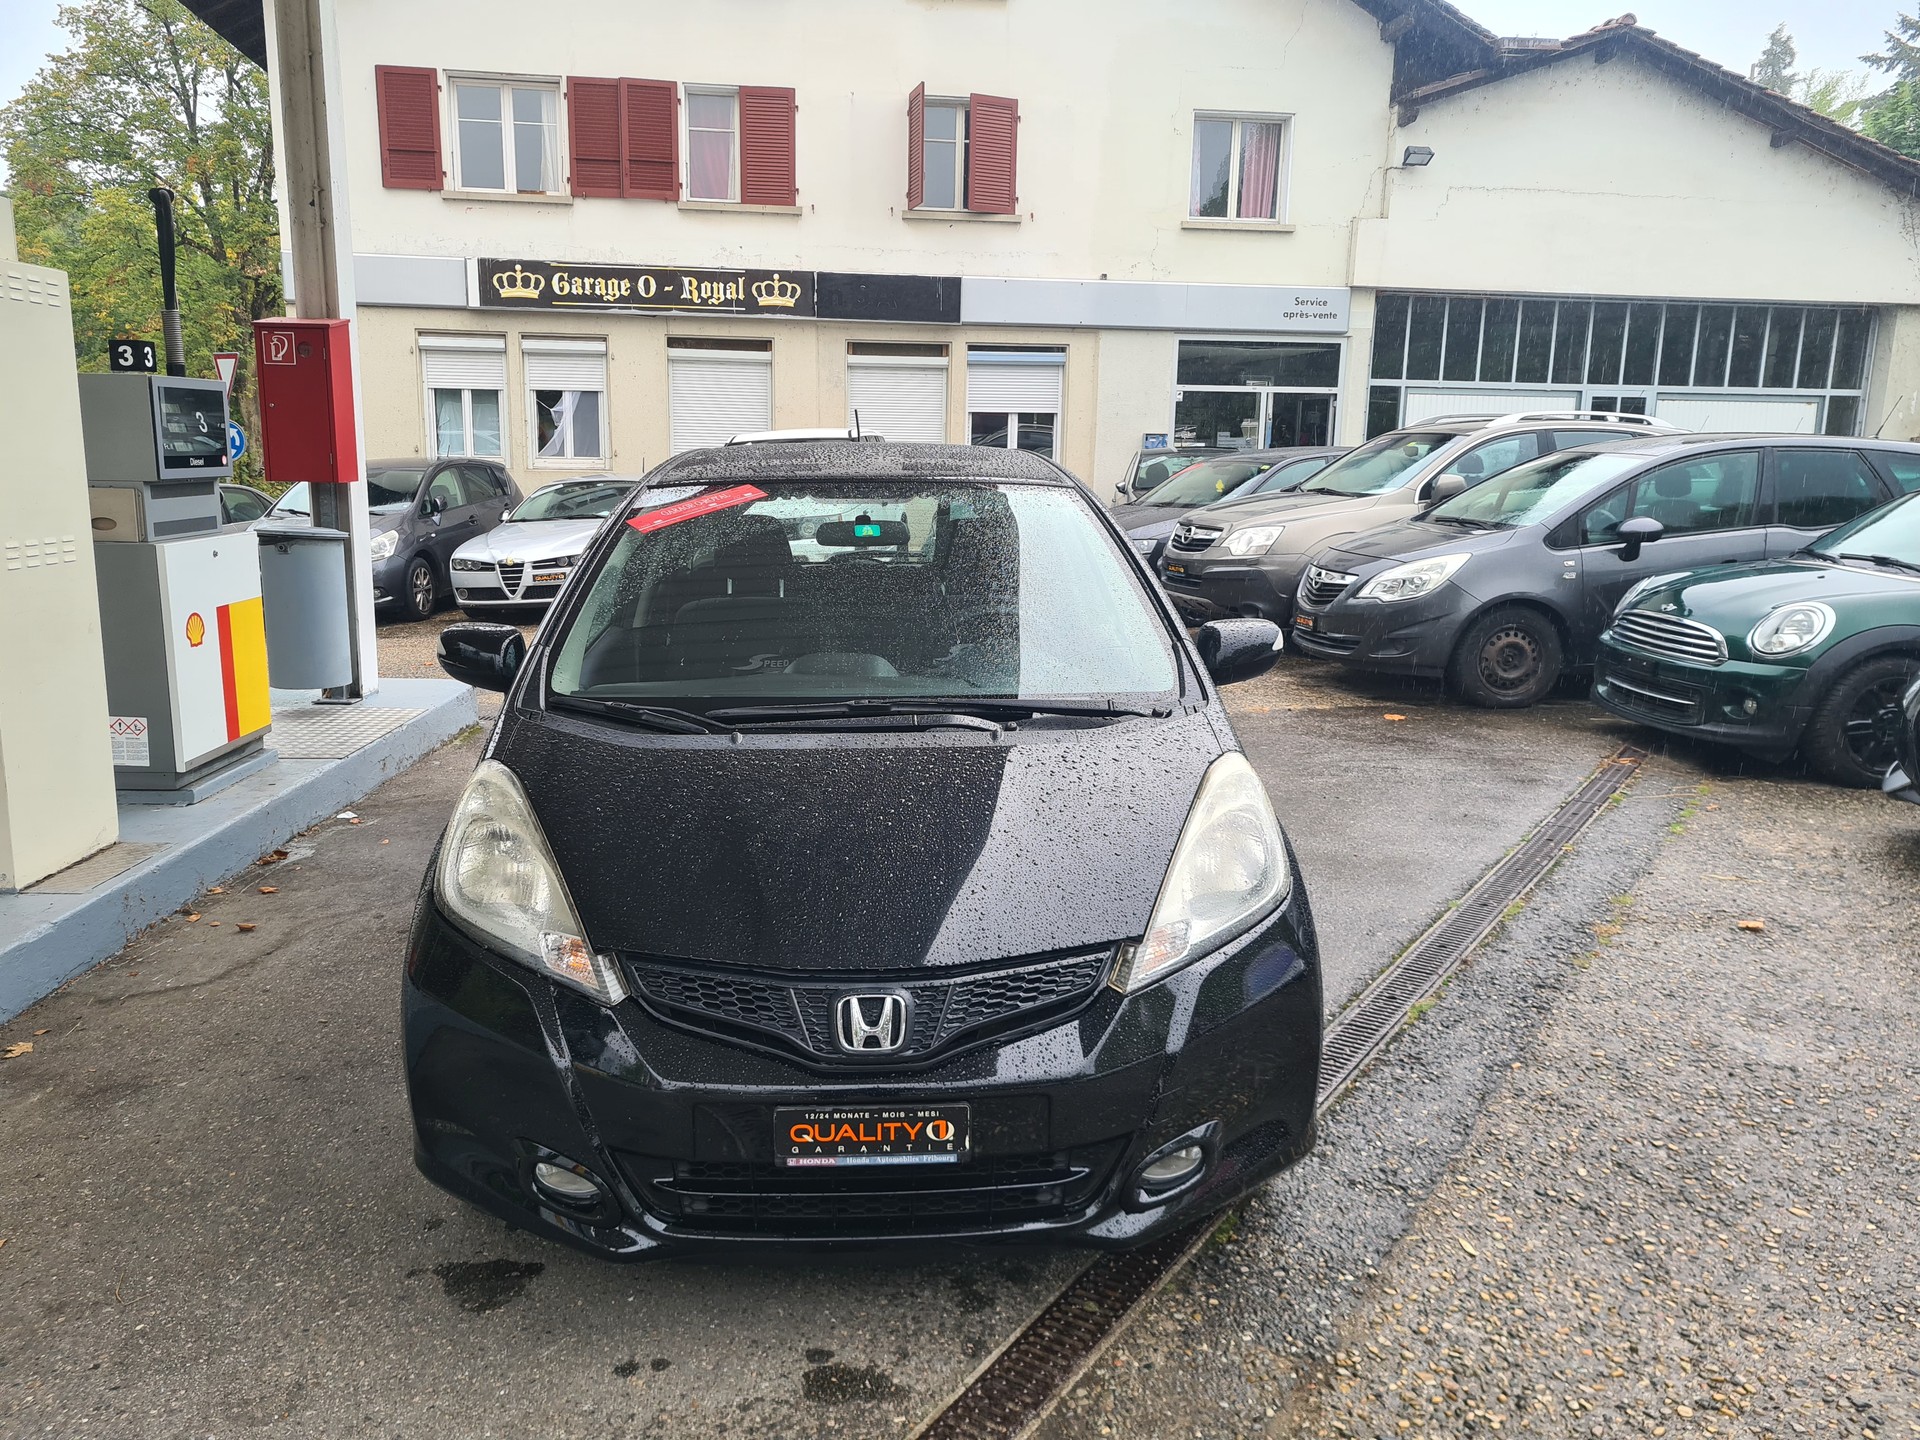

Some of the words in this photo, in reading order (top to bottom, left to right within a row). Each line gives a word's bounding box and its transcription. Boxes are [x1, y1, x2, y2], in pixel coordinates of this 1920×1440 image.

[551, 272, 631, 302] Garage
[637, 275, 657, 298] O
[680, 276, 746, 305] Royal
[1294, 296, 1328, 307] Service
[1282, 310, 1338, 321] après-vente
[117, 344, 134, 367] 3
[143, 346, 154, 368] 3
[195, 411, 208, 433] 3
[189, 457, 205, 466] Diesel
[790, 1122, 923, 1142] QUALITY
[846, 1156, 870, 1164] Honda
[923, 1154, 955, 1163] Fribourg
